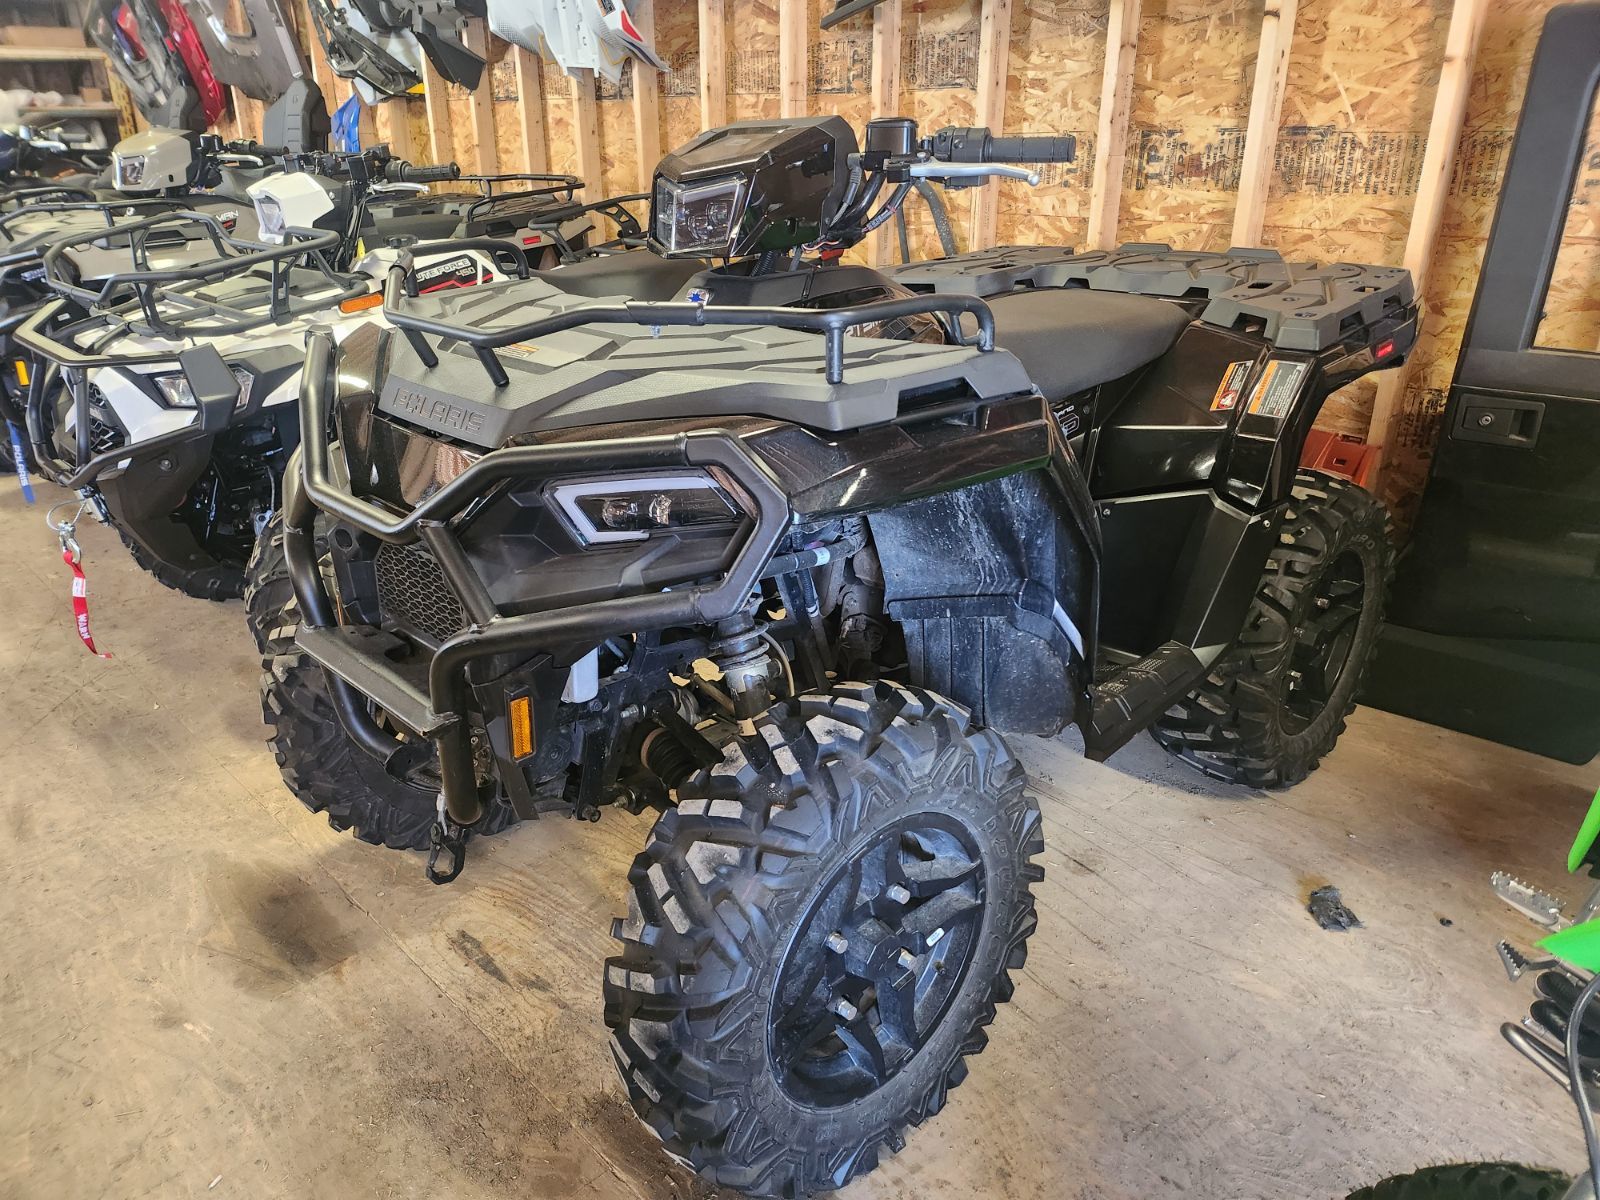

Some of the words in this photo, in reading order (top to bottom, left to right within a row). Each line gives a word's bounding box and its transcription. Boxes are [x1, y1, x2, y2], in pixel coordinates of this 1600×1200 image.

[1334, 136, 1349, 194] INSTALLATION
[1342, 136, 1356, 194] INFORMATION
[436, 257, 472, 275] FORCE
[455, 266, 476, 277] 450
[392, 388, 486, 436] POLARIS
[12, 444, 29, 487] POLARIS
[77, 613, 91, 640] WARN
